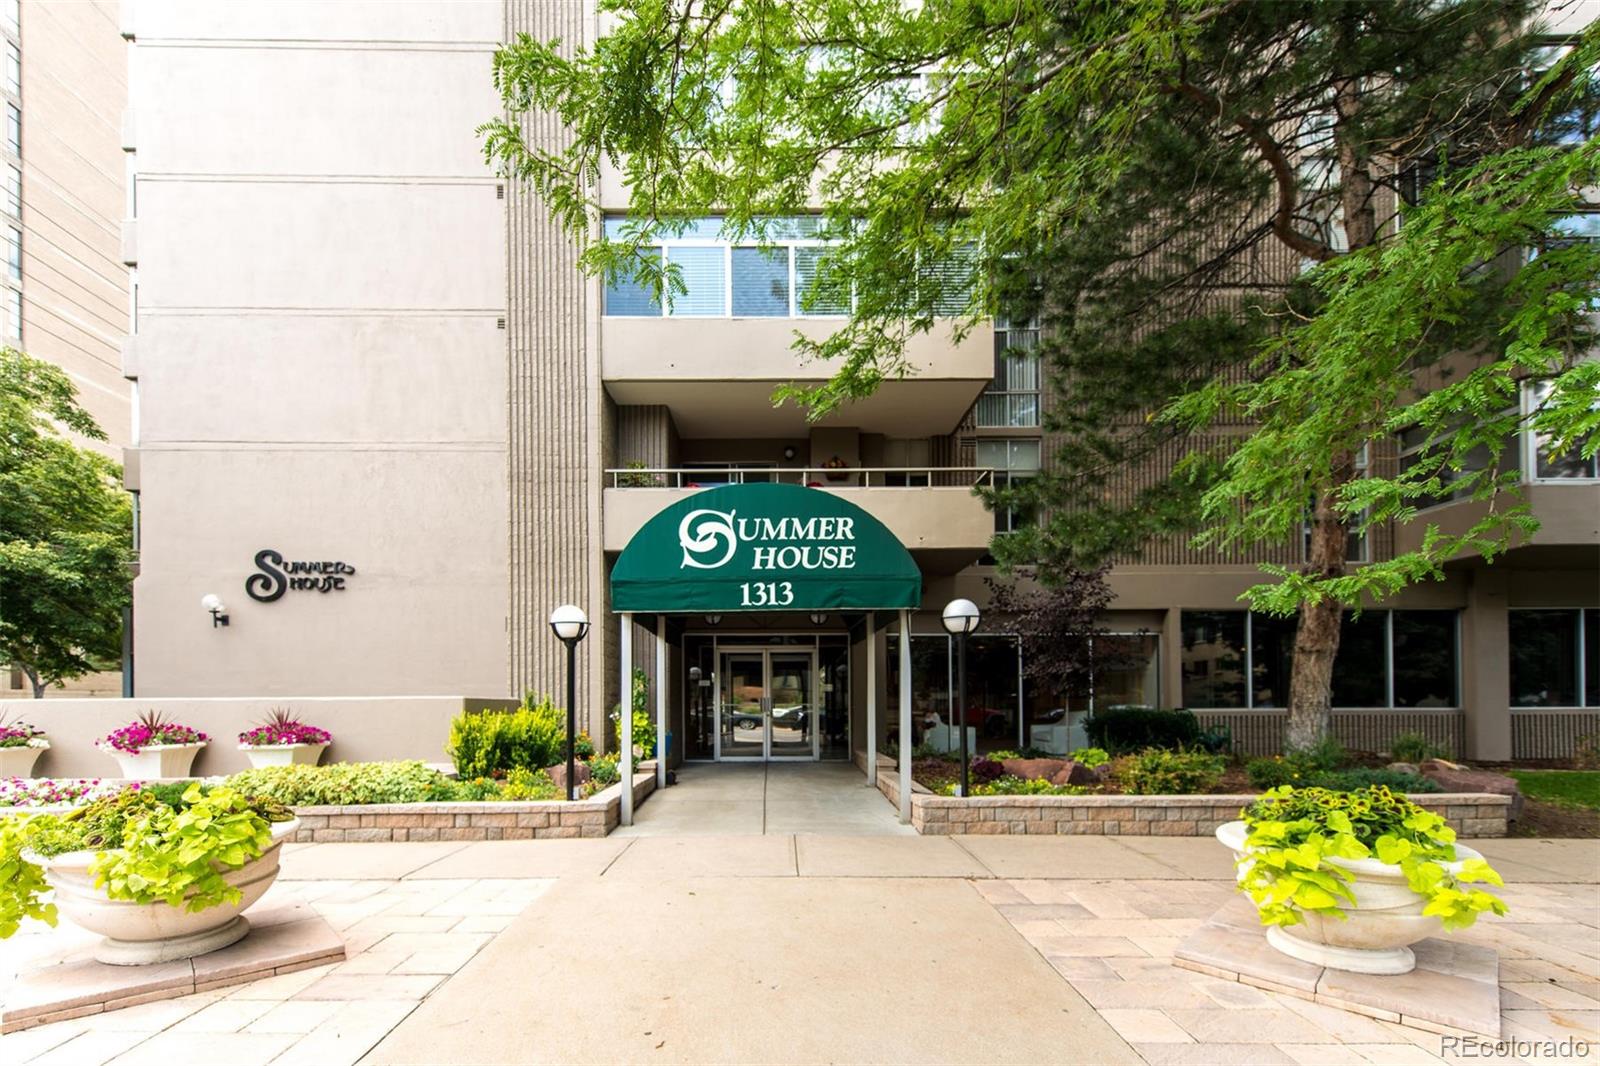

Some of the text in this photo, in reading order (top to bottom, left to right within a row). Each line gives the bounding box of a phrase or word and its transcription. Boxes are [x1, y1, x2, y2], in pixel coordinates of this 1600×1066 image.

[678, 508, 856, 570] SUMMER
[751, 546, 856, 570] HOUSE
[289, 576, 346, 593] HOUSE
[740, 581, 794, 606] 1313
